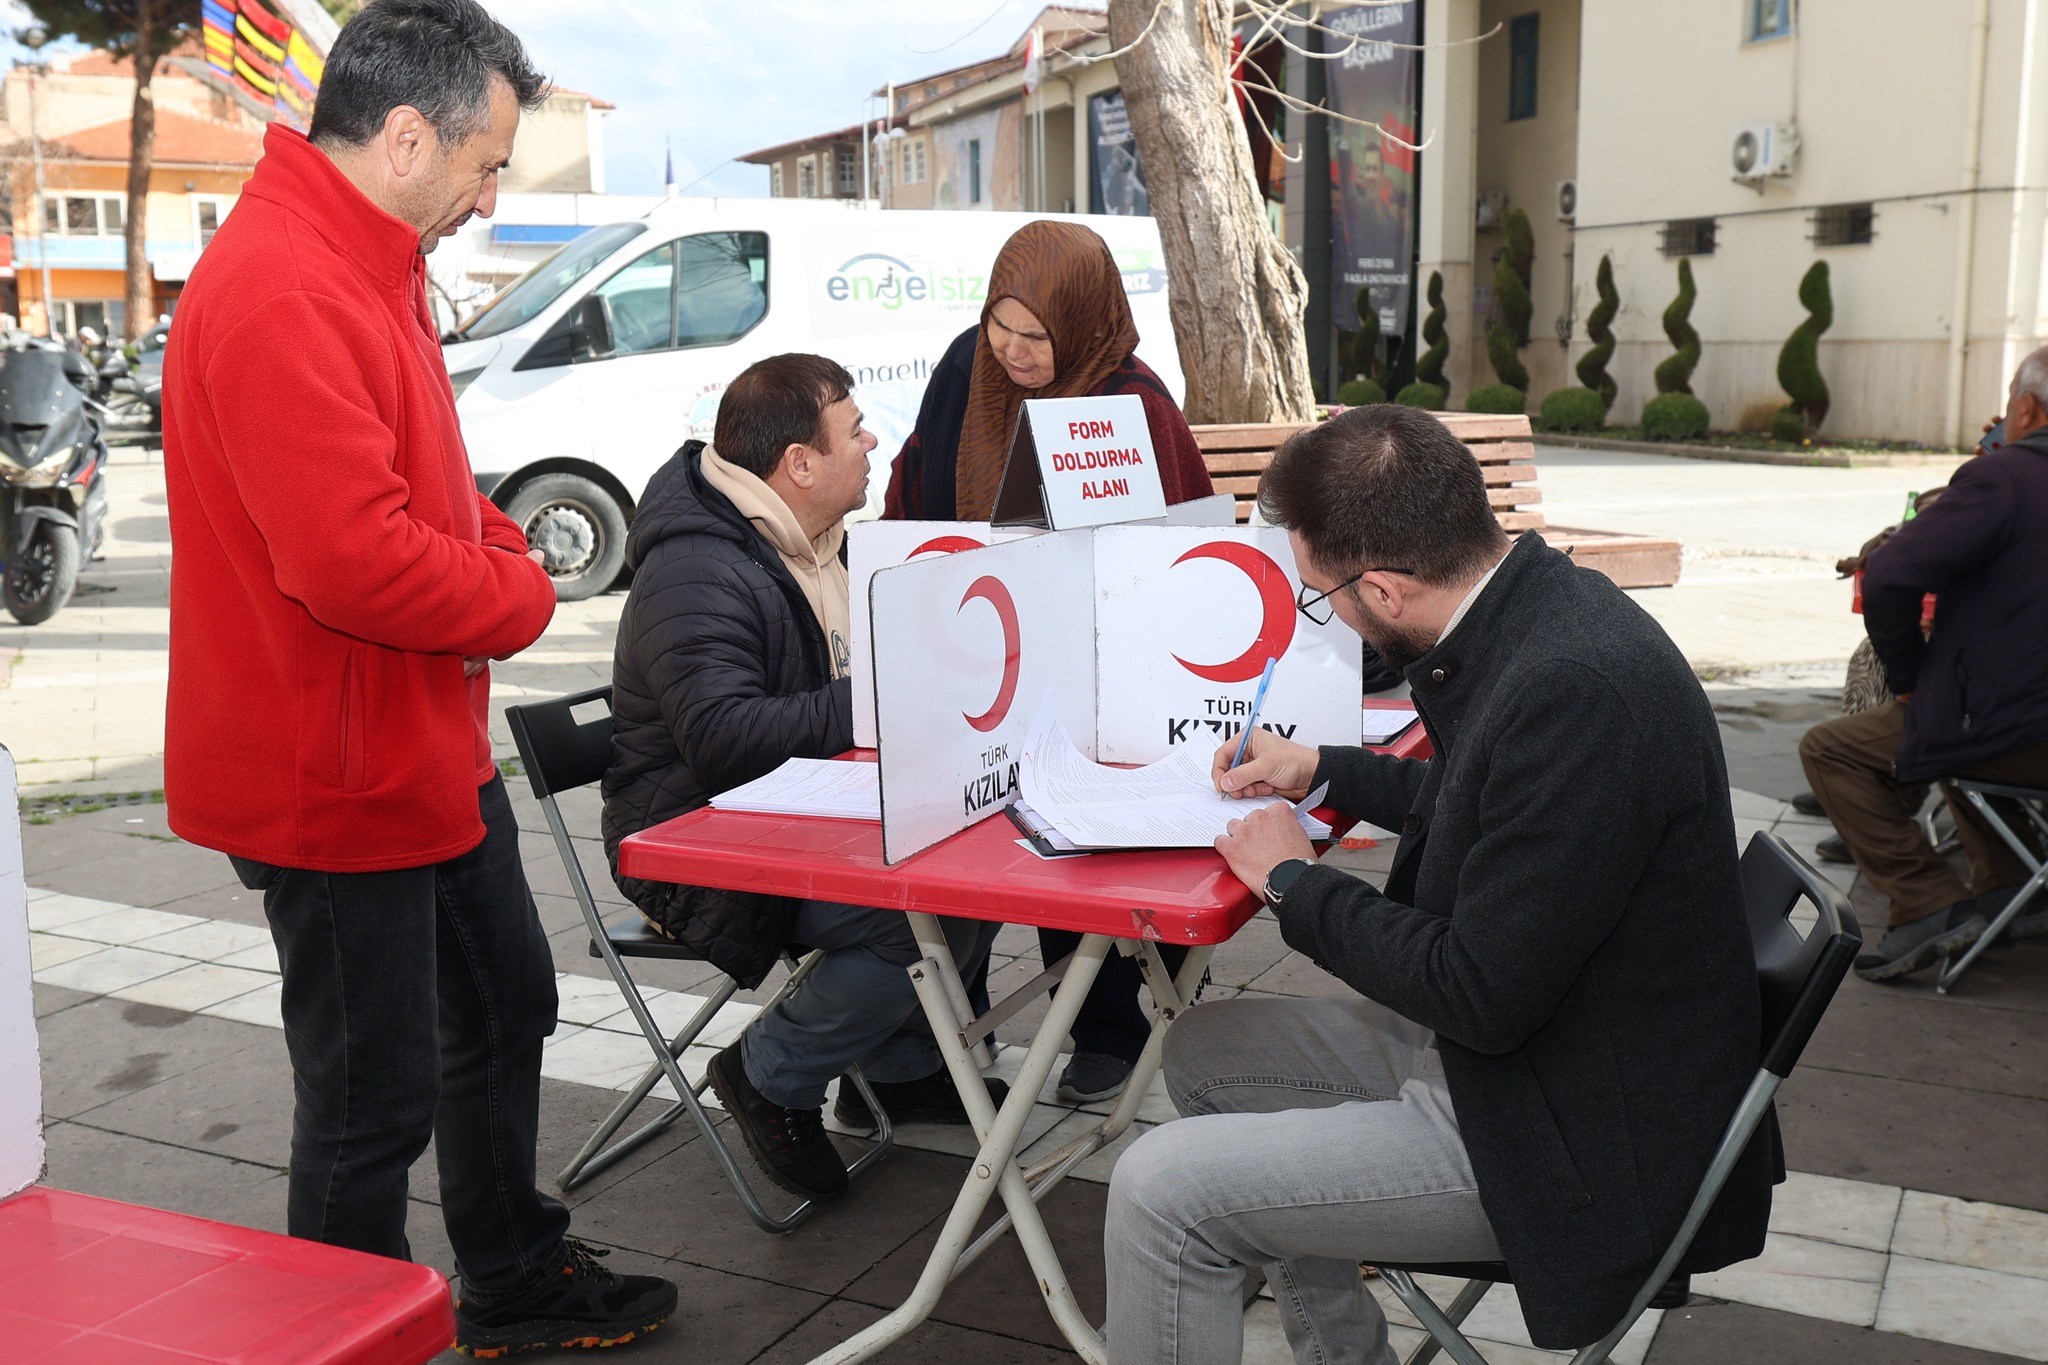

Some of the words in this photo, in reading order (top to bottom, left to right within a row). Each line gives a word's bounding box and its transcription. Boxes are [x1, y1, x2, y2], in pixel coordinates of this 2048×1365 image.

[826, 267, 987, 310] engelsiz
[1068, 420, 1114, 440] FORM
[1052, 448, 1143, 472] DOLDURMA
[1082, 478, 1129, 500] ALANI
[981, 743, 1008, 769] TÜRK
[964, 761, 1019, 812] KIZILA
